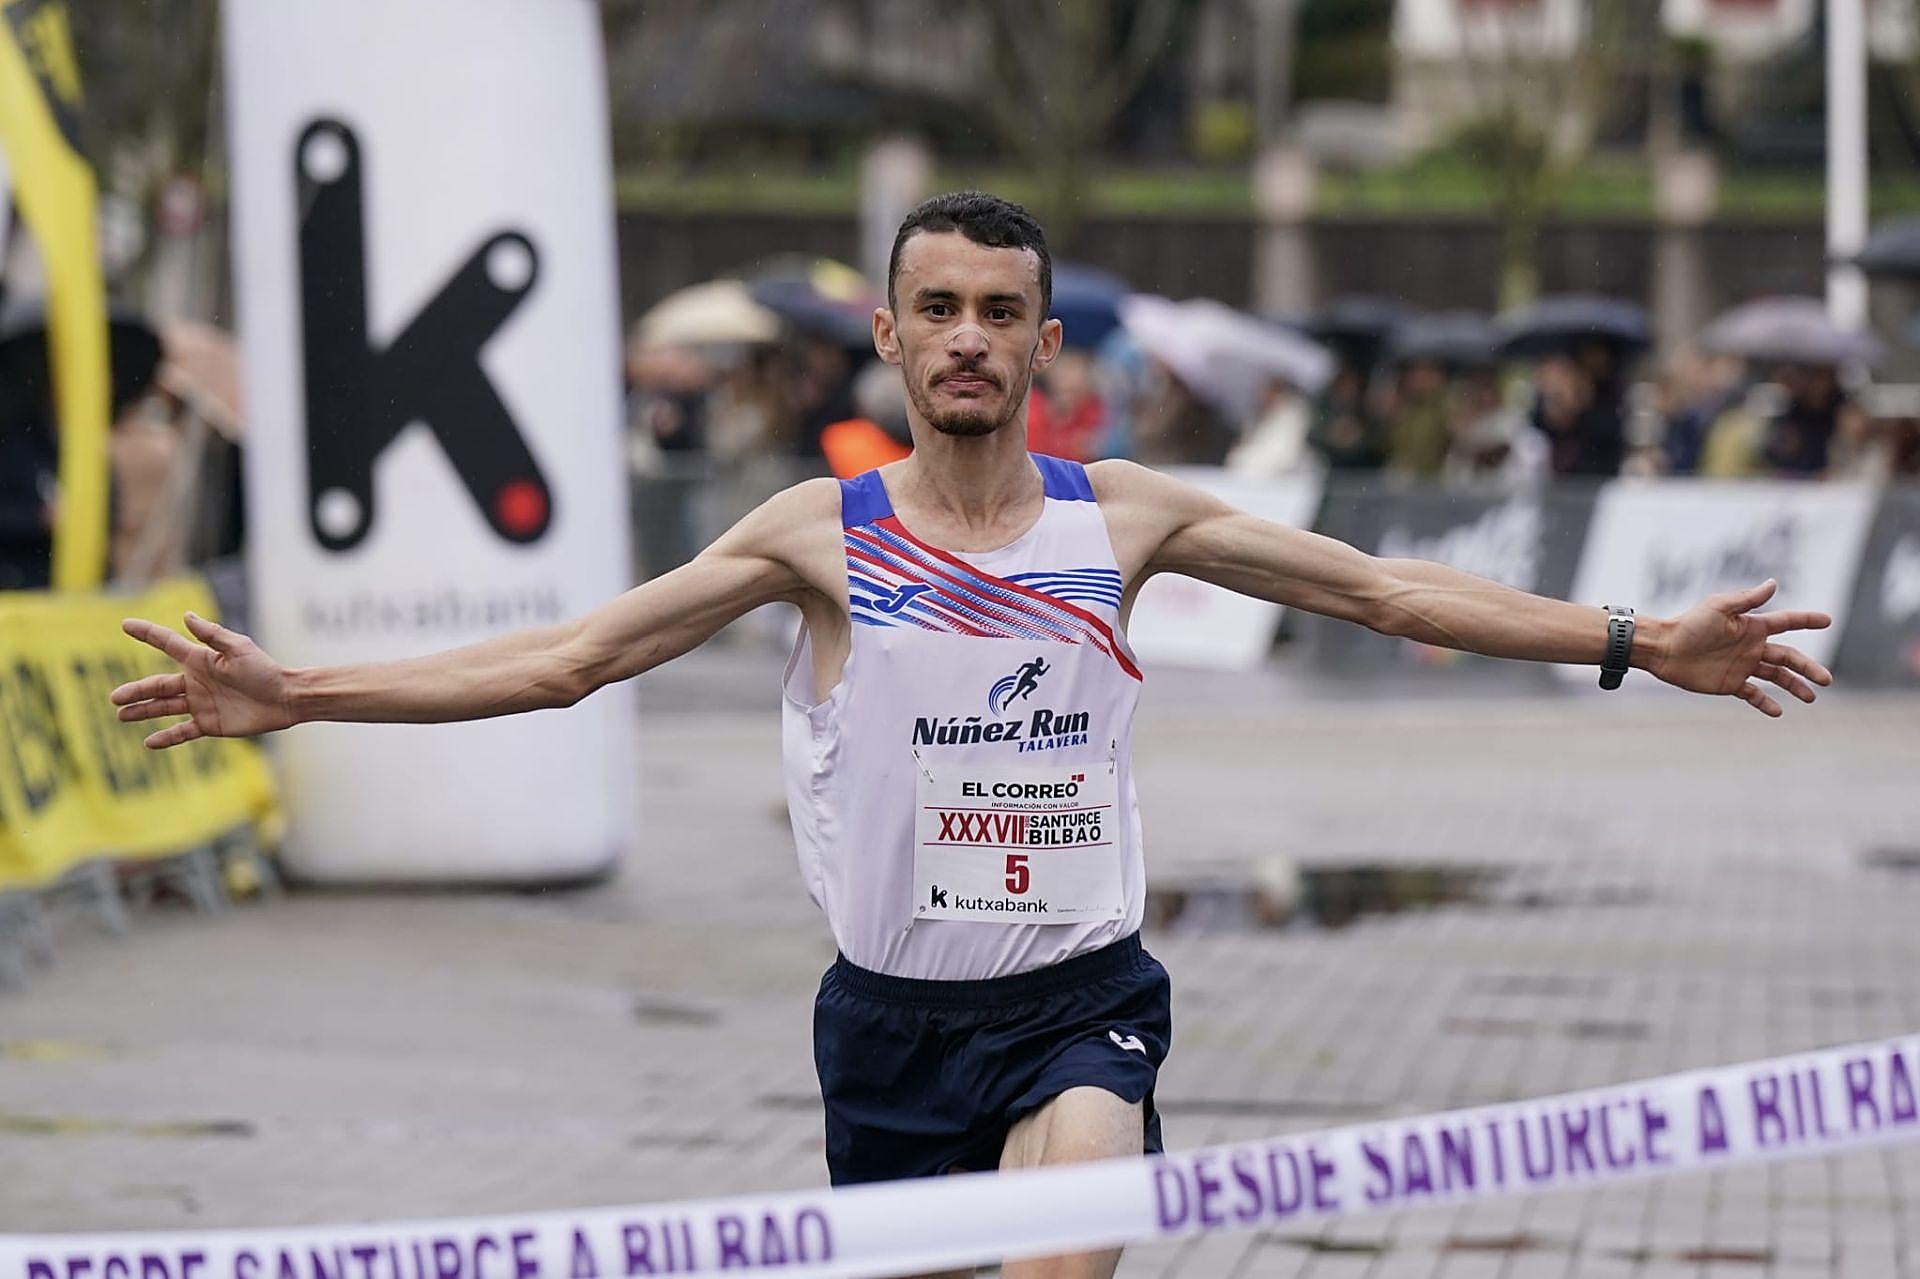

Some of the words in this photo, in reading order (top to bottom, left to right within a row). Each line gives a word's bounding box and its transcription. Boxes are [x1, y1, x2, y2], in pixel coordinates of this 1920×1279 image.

[912, 715, 1023, 745] Núñez
[1029, 709, 1089, 738] Run
[1018, 733, 1088, 753] TALAVERA
[962, 782, 989, 797] EL
[992, 782, 1079, 799] CORREO
[991, 802, 1041, 810] INFORMACIÓN
[1059, 801, 1079, 809] VALOR
[938, 812, 1025, 844] XXXVII
[1029, 811, 1101, 829] SANTURCE
[1029, 825, 1101, 845] BILBAO
[1005, 854, 1030, 894] 5
[955, 895, 1048, 913] kutxabank
[1153, 1146, 1341, 1232] DESDE
[1361, 1094, 1672, 1204] SANTURCE
[1698, 1086, 1729, 1151] A
[1749, 1050, 1919, 1145] BILBA
[569, 1228, 598, 1279] A
[621, 1208, 833, 1277] BILBAO
